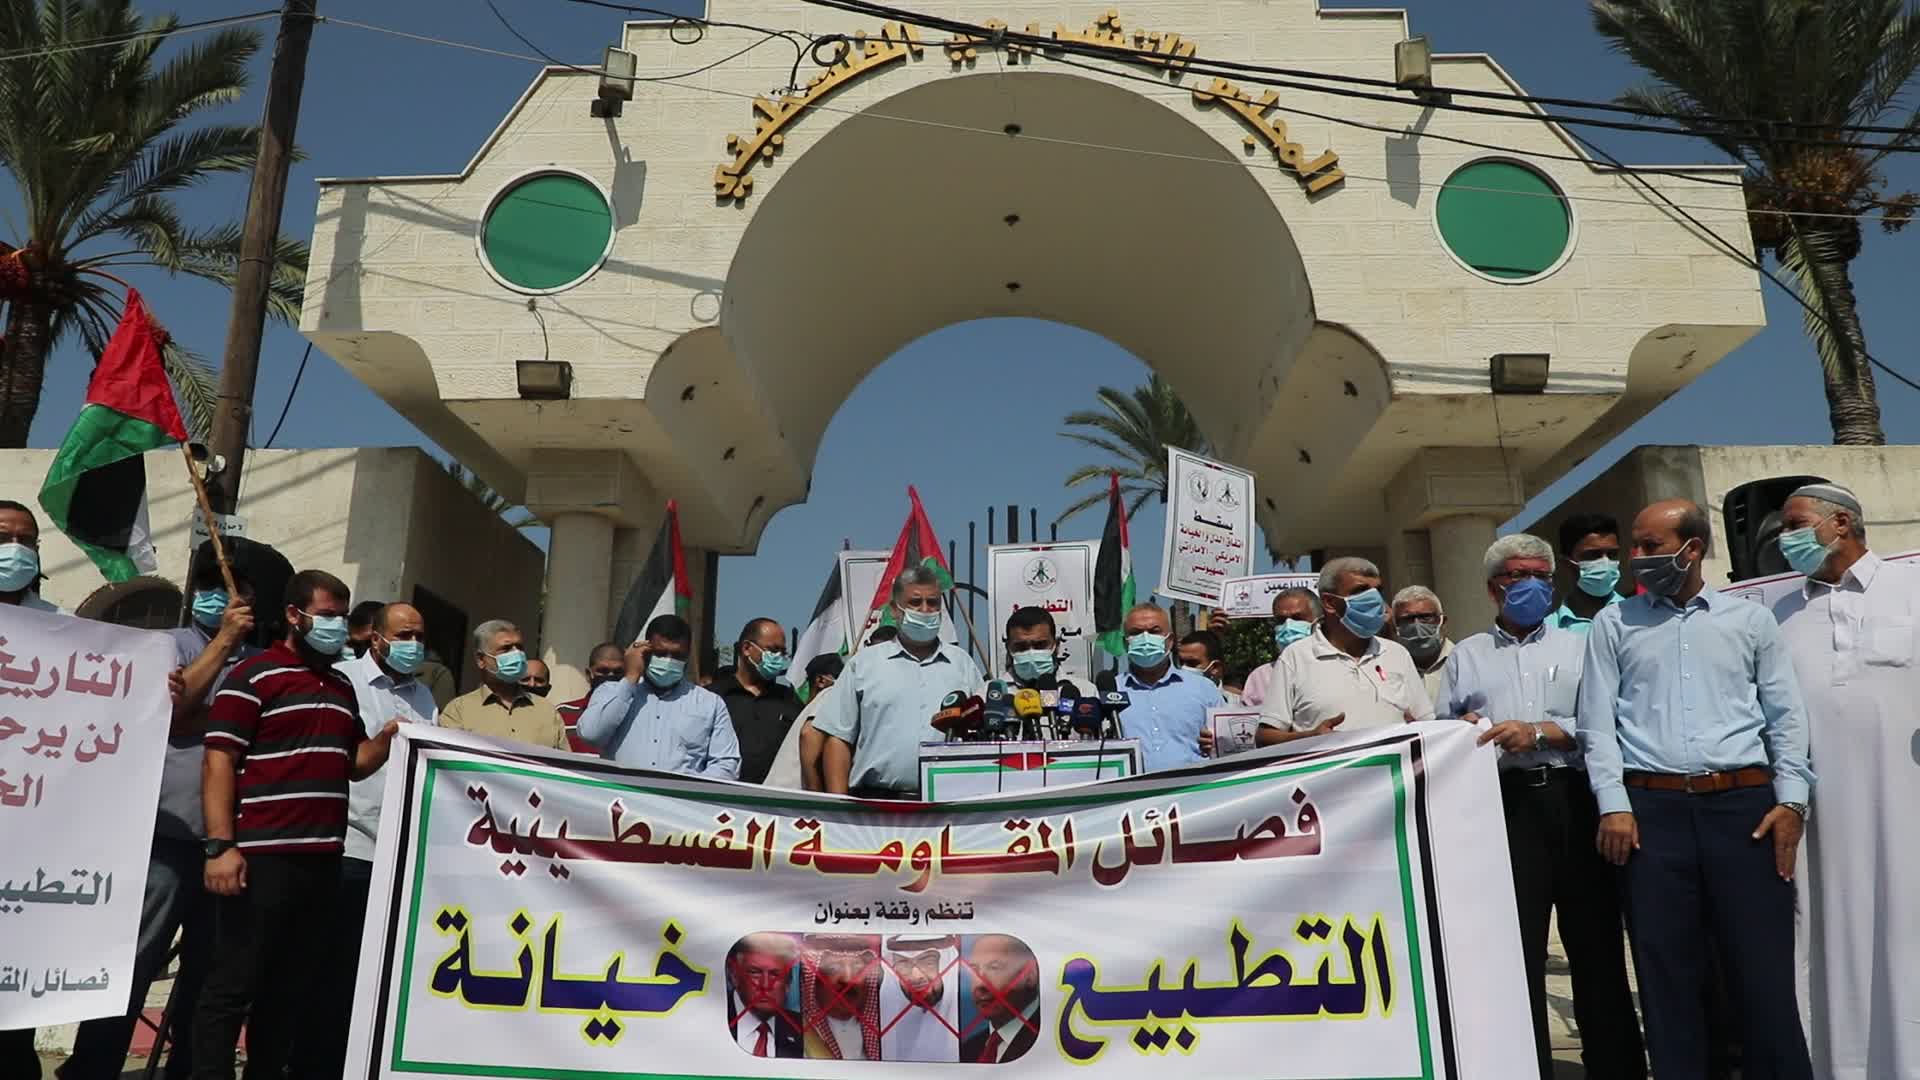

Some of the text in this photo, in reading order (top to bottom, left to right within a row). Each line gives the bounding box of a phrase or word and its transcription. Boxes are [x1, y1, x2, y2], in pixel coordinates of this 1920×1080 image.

[714, 8, 1345, 200] المجلس التشريعي الفلسطيني
[1193, 509, 1233, 535] يسقط
[74, 721, 124, 763] لن
[788, 817, 1075, 893] المقاومة
[1091, 787, 1322, 887] فصائل
[814, 900, 975, 925] تنظم وقفة بعنوان
[31, 967, 109, 999] فصائل
[430, 908, 1395, 1062] التطبيع خيانة
